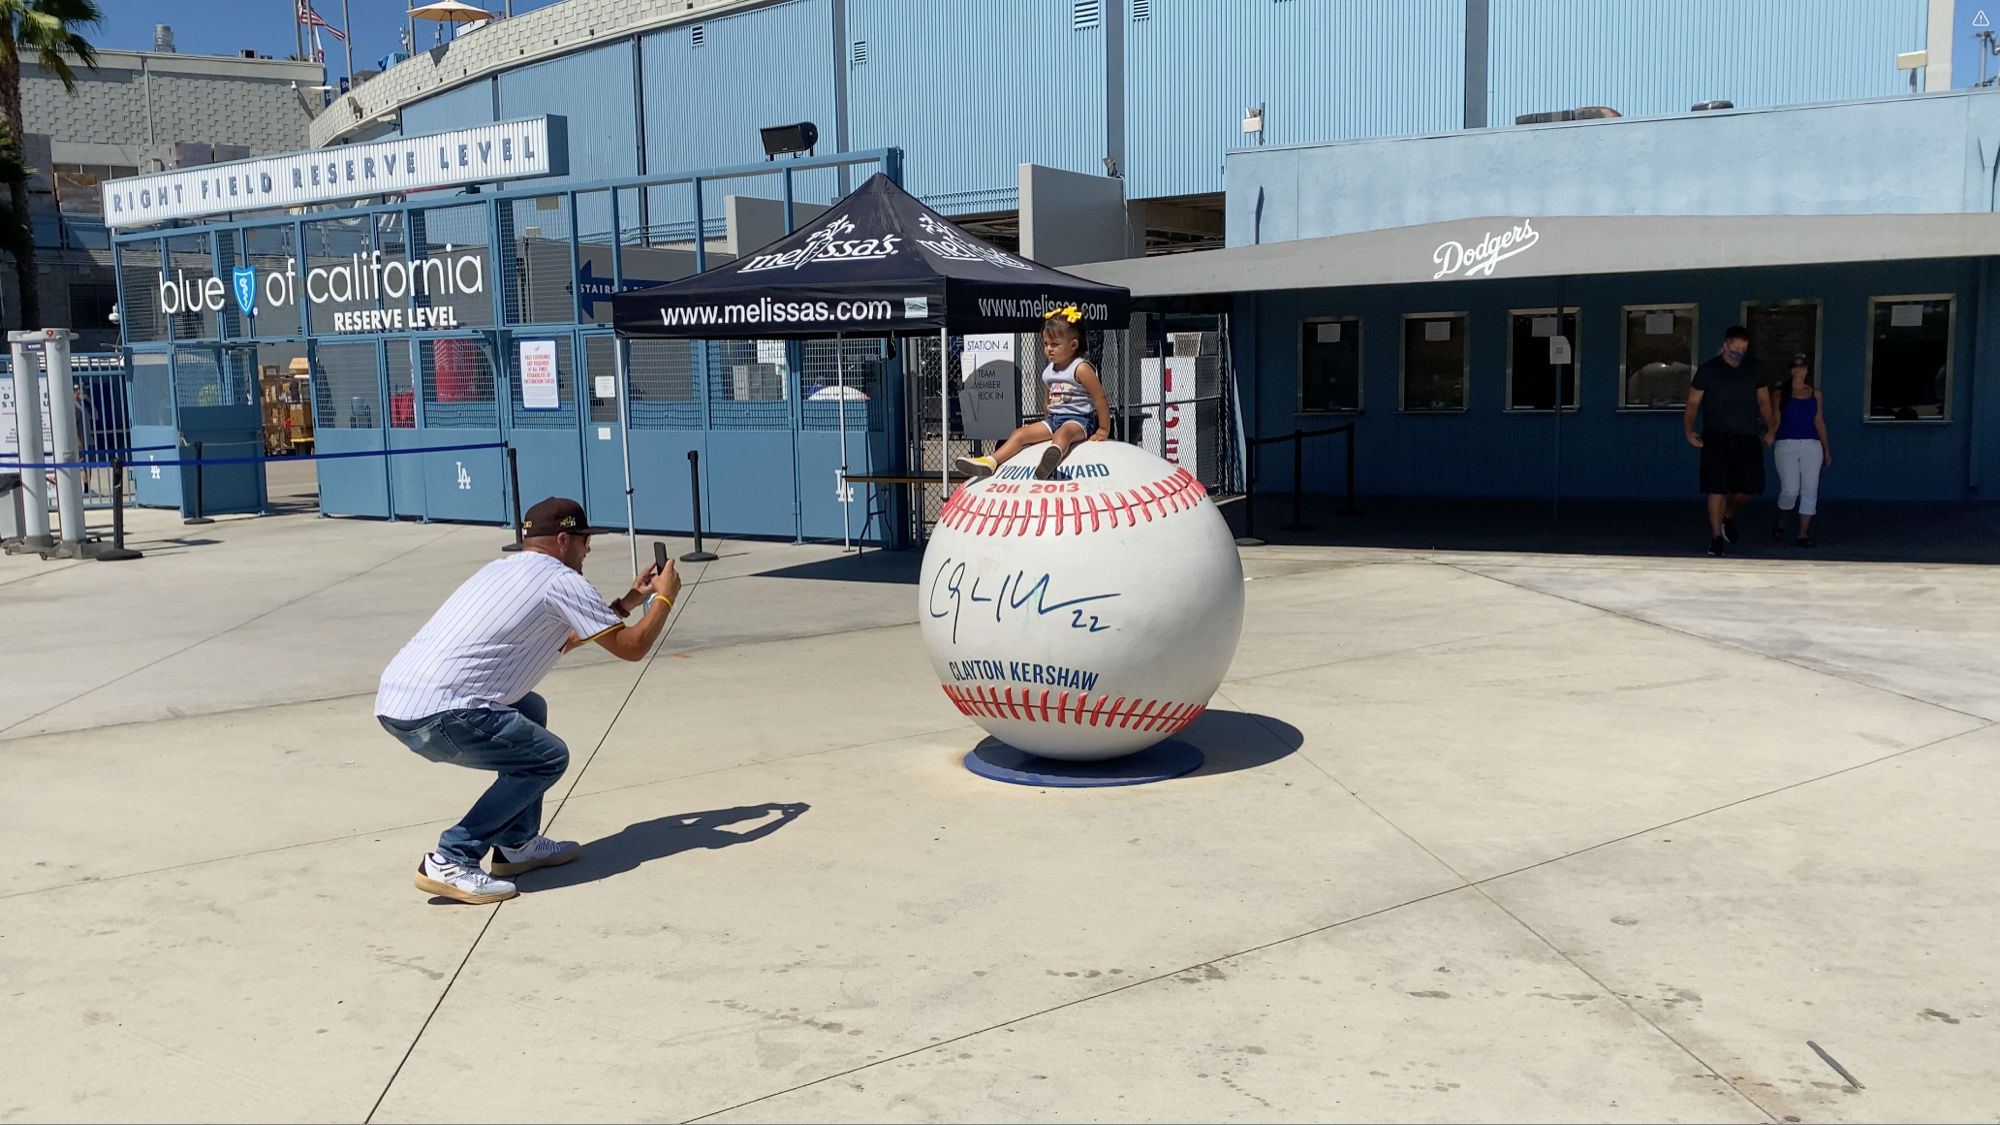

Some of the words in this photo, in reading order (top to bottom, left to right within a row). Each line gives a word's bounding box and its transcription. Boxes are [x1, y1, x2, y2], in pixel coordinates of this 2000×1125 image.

[113, 183, 183, 212] RIGHT
[201, 171, 272, 200] FIELD
[292, 151, 416, 188] RESERVE
[439, 135, 534, 170] LEVEL
[1433, 219, 1540, 280] Dodgers
[159, 269, 226, 314] blue
[265, 258, 297, 307] of
[306, 242, 483, 304] california
[334, 308, 402, 331] RESERVE
[408, 306, 457, 327] LEVEL
[660, 297, 892, 326] www.melissas.com
[967, 340, 1000, 351] STATION
[1002, 340, 1009, 350] 4
[973, 380, 1001, 389] MEMBER
[977, 369, 996, 378] TEAM
[456, 461, 471, 490] LA
[996, 464, 1042, 481] YOUN
[1047, 462, 1110, 481] AWARD
[985, 483, 1021, 494] 2011
[1029, 482, 1080, 494] 2013
[1071, 608, 1111, 633] 22
[949, 659, 1006, 682] CLAYTON
[1009, 660, 1100, 693] KERSHAW
